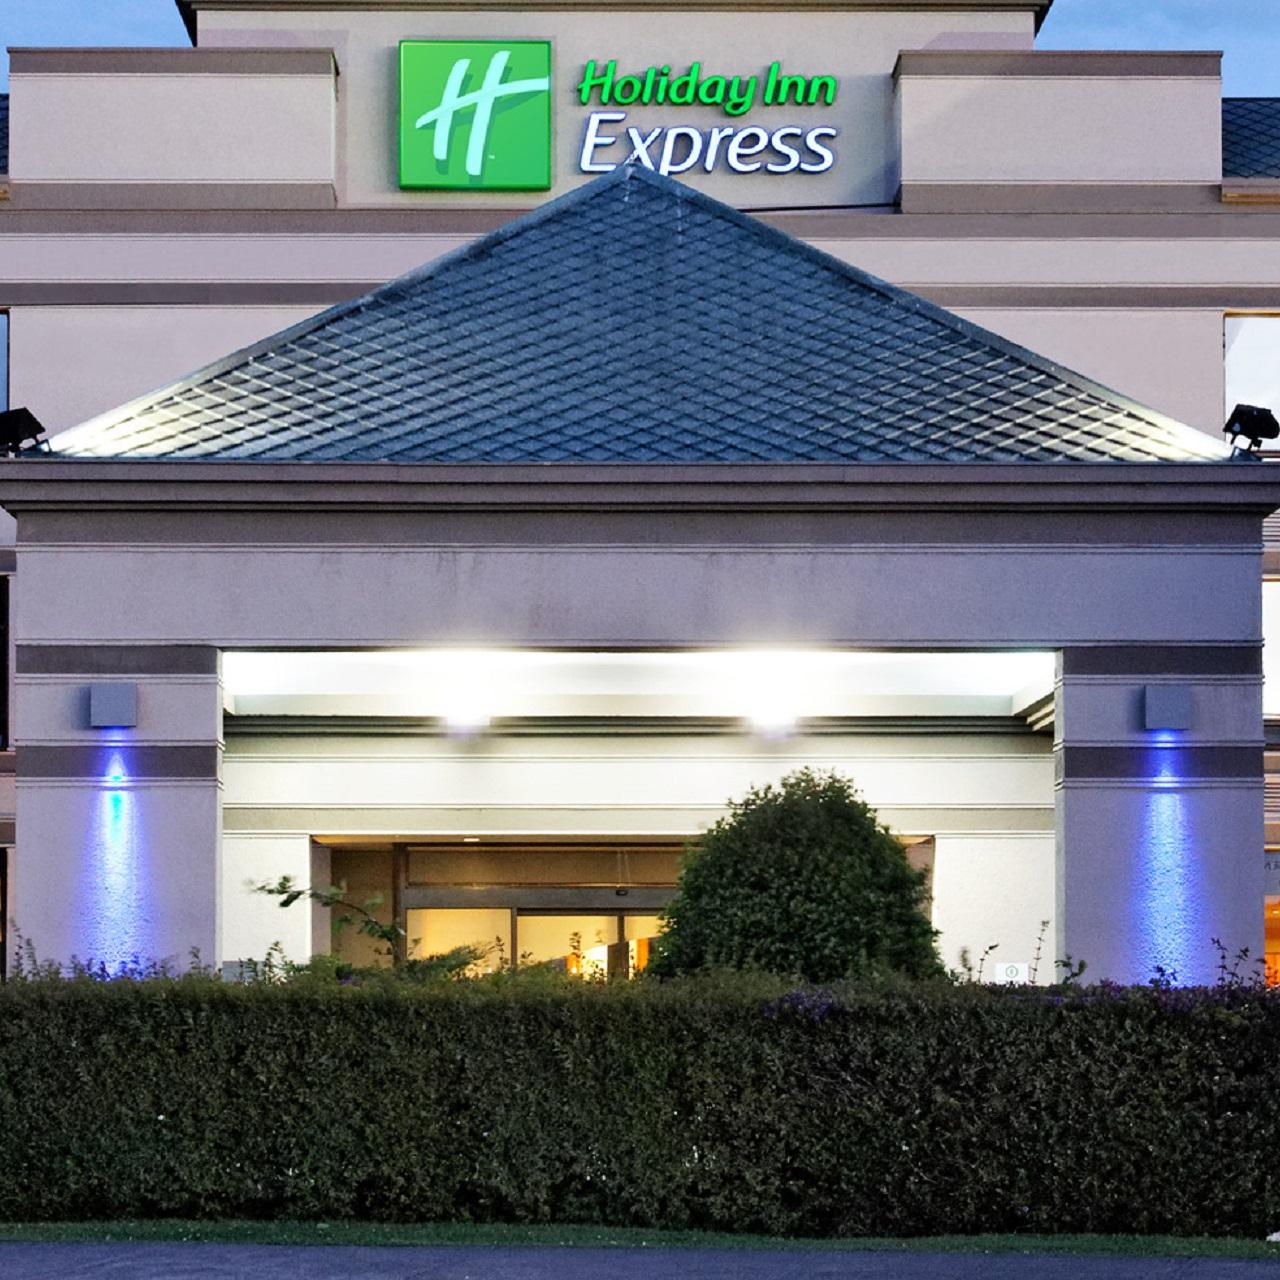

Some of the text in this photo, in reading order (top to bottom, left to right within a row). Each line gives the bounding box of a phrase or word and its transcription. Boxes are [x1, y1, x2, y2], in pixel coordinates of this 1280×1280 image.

[415, 50, 549, 176] H
[577, 59, 837, 116] Holiday Inn
[578, 111, 838, 177] Express
